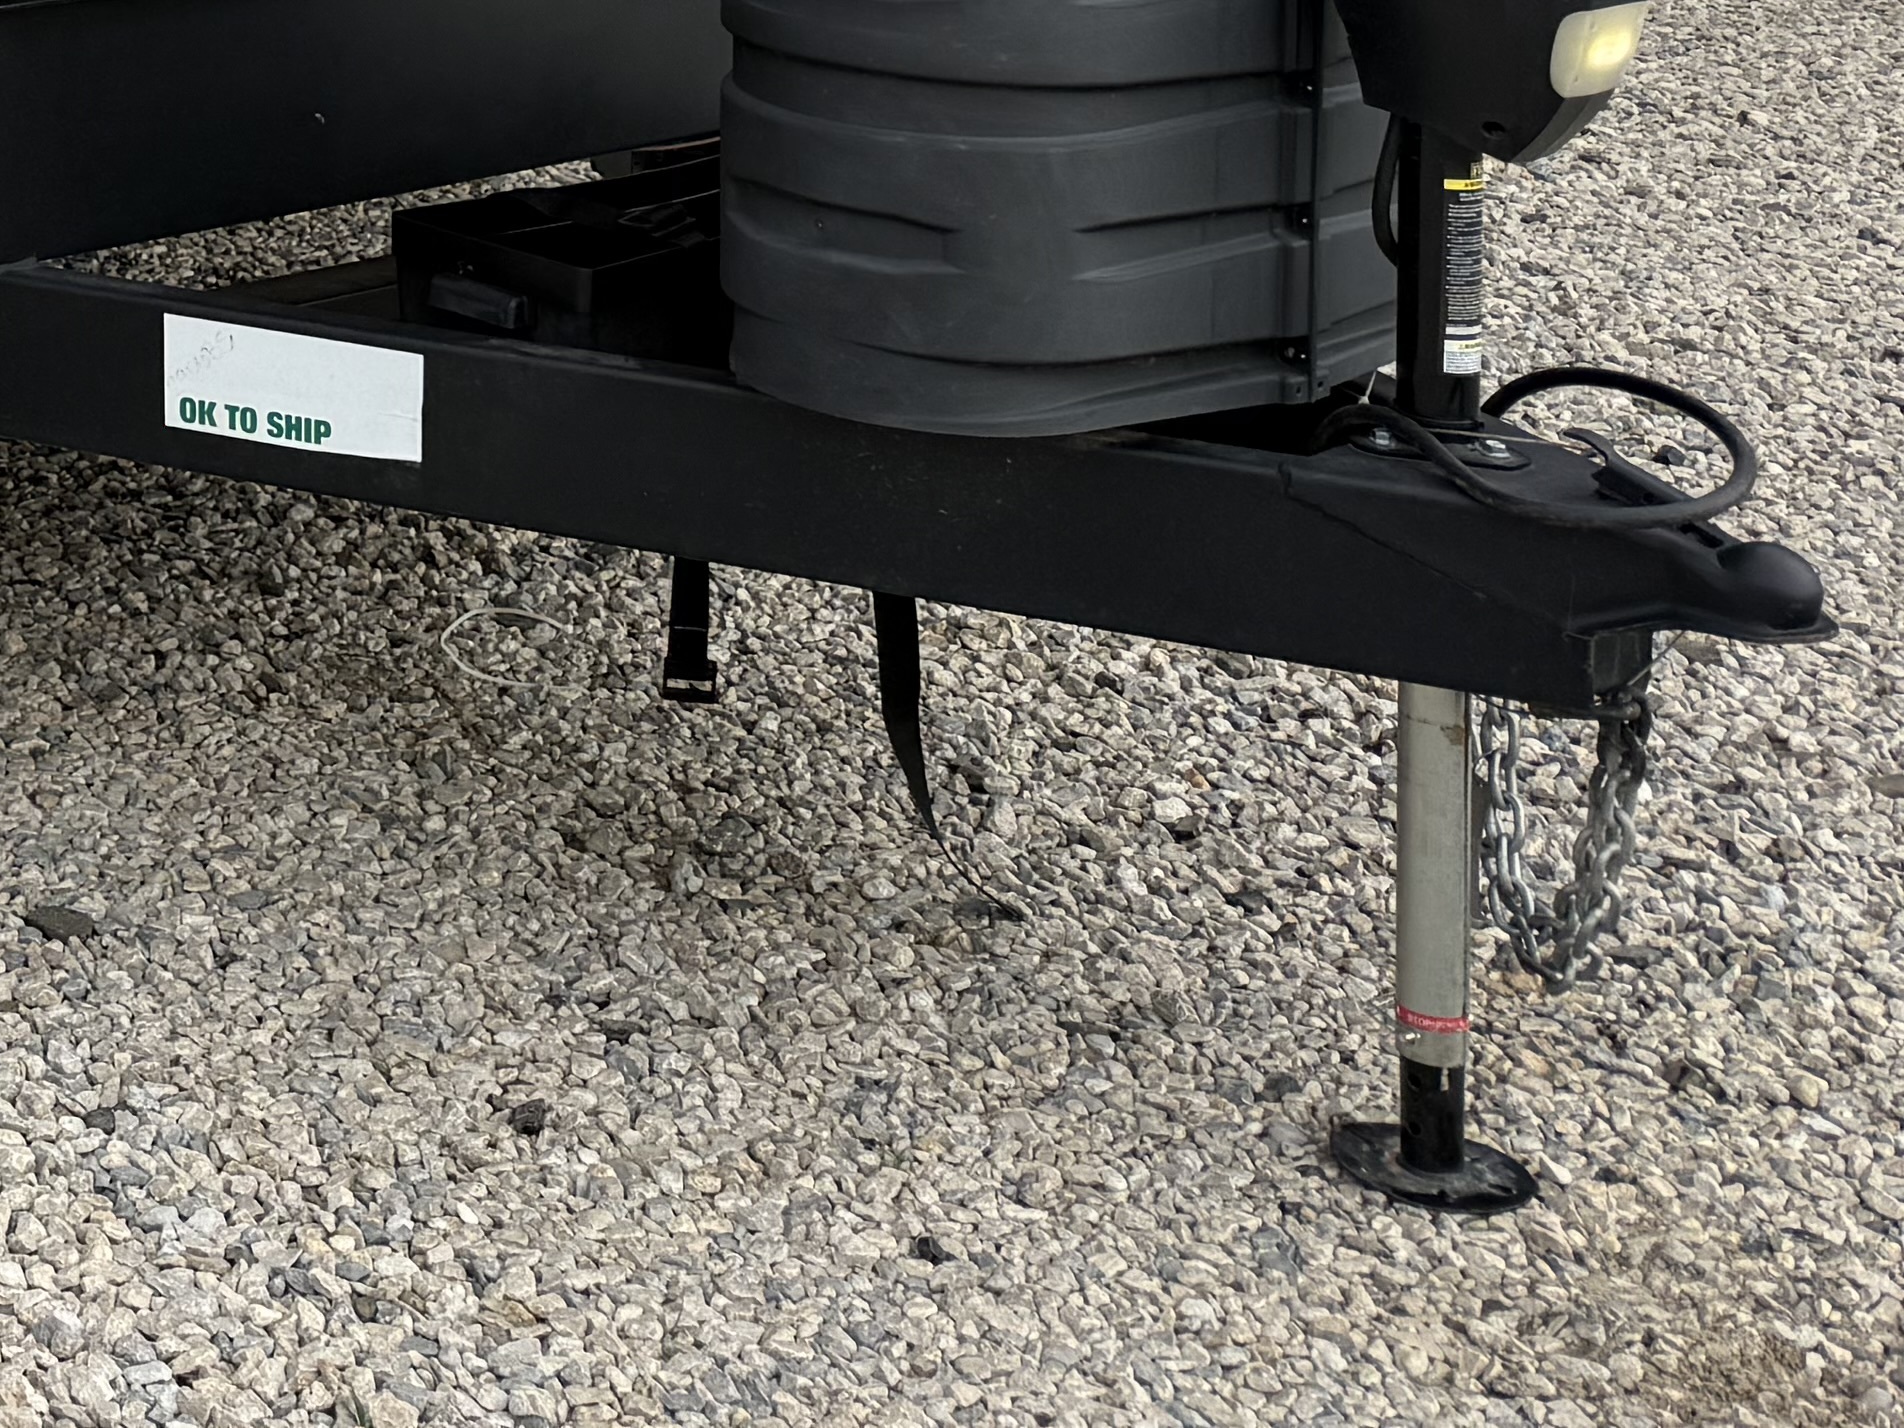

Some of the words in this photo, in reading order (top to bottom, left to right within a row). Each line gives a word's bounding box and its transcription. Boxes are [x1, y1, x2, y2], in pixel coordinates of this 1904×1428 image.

[178, 396, 218, 428] OK
[224, 403, 258, 435] TO
[266, 411, 333, 446] SHIP
